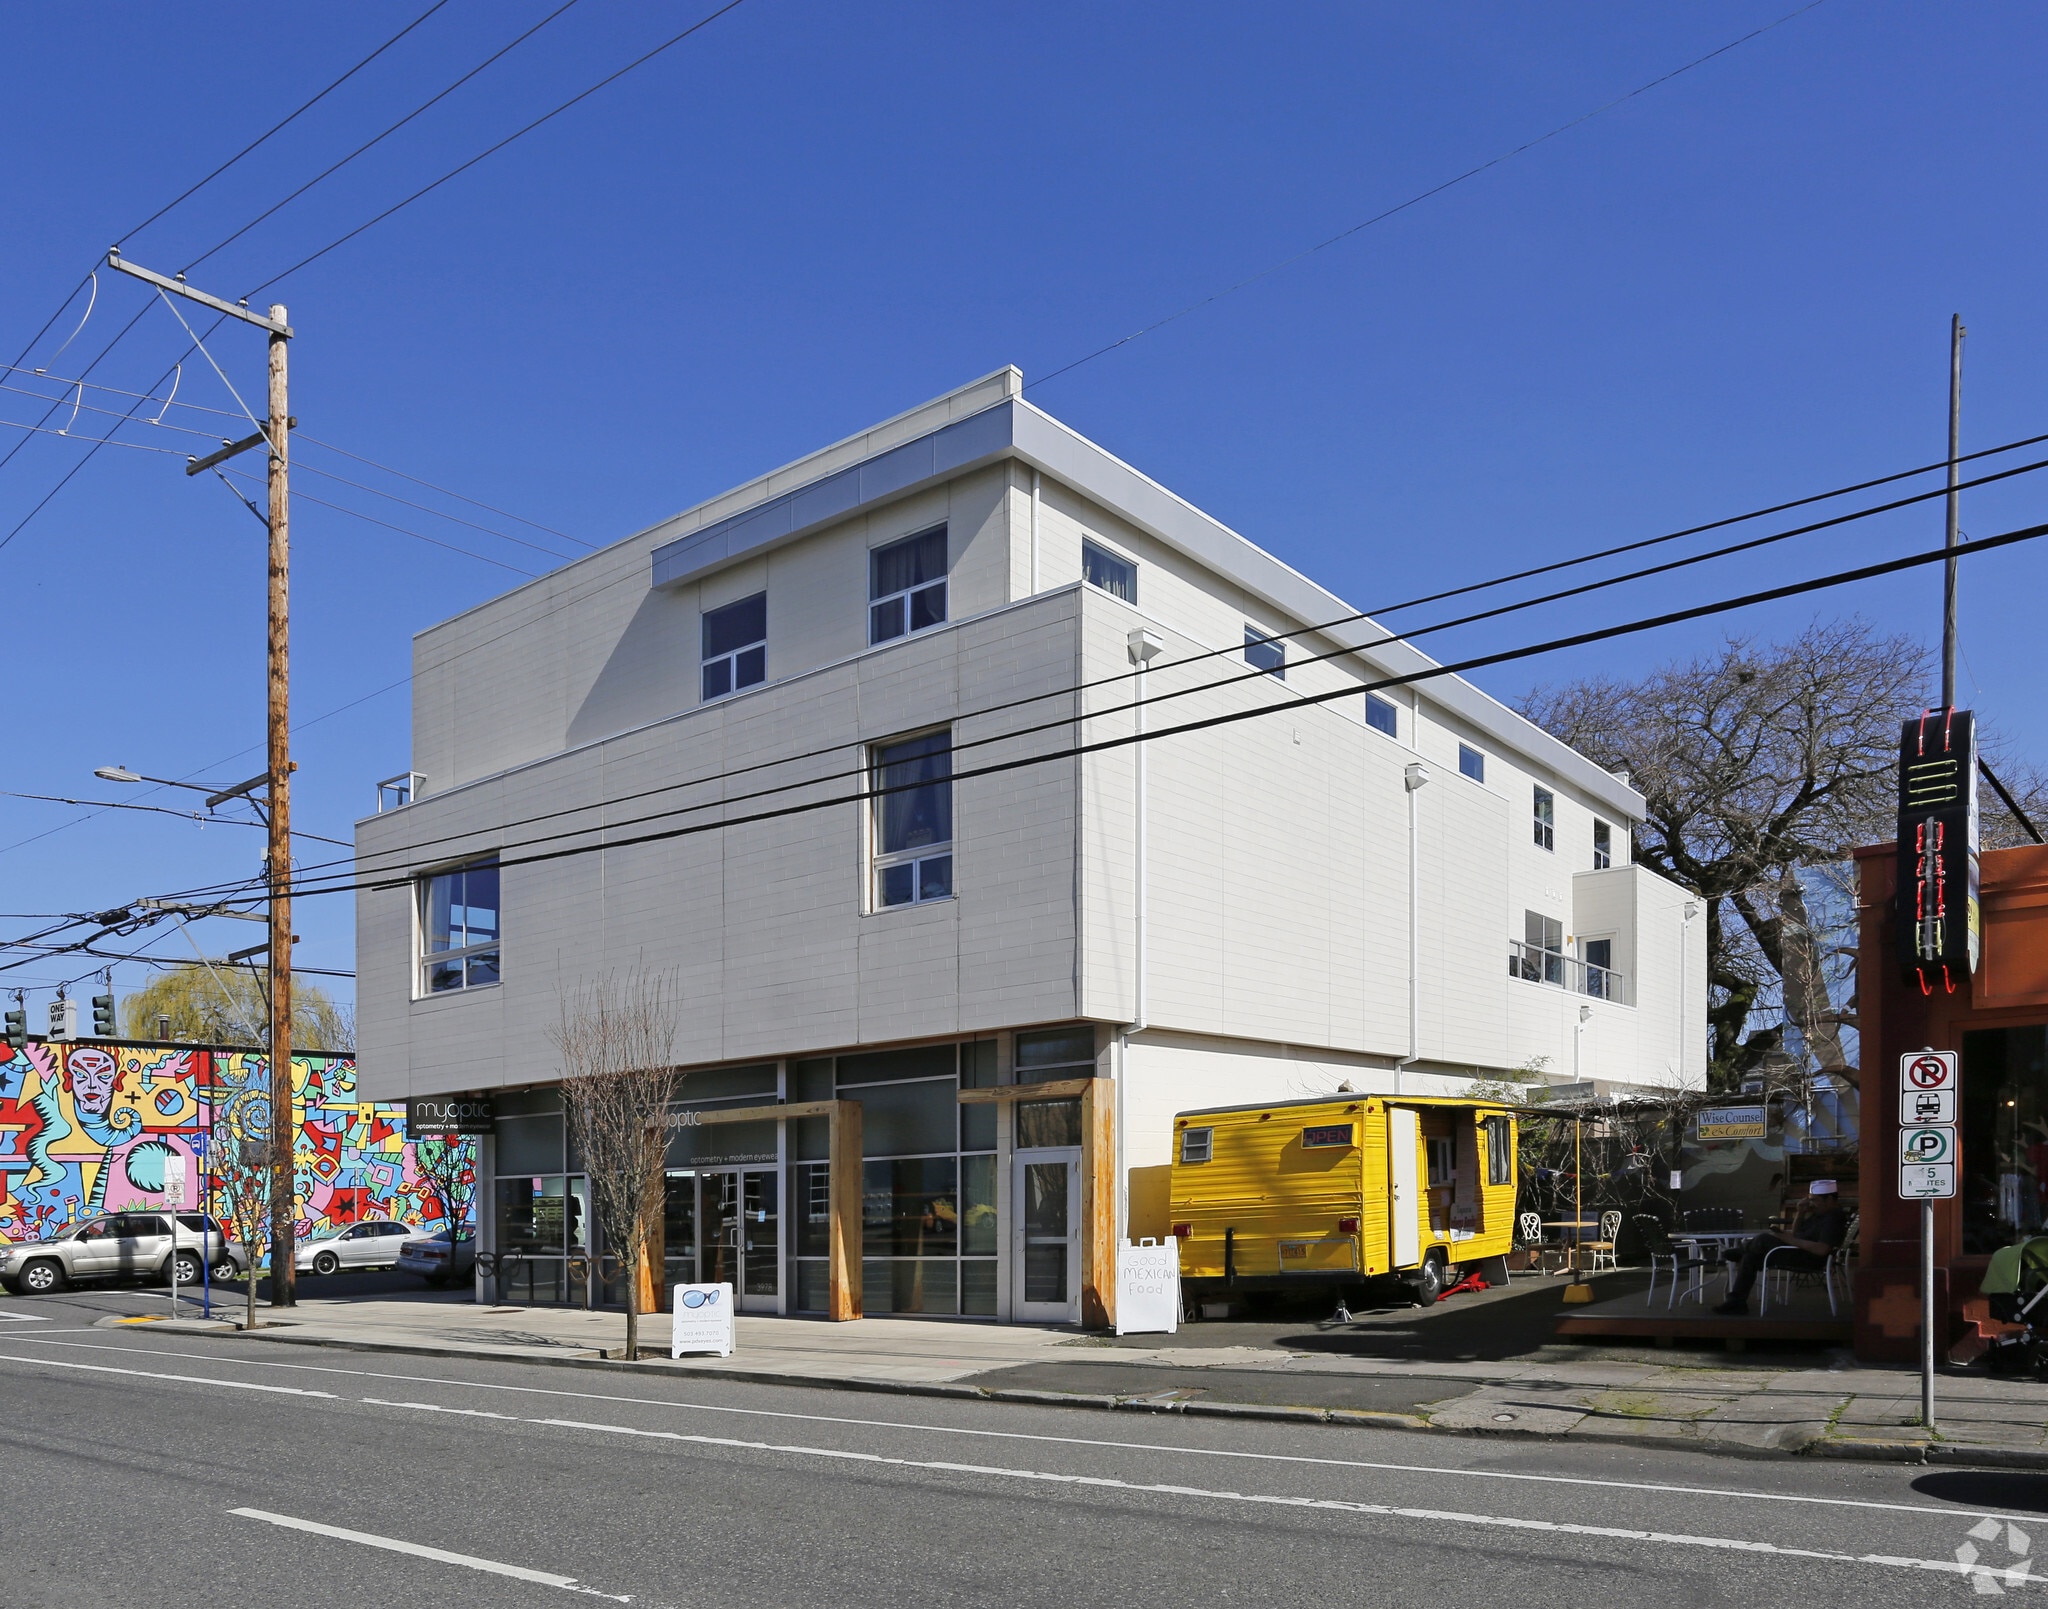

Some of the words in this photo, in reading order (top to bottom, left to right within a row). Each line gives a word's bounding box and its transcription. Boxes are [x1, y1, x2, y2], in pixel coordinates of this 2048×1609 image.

[50, 1003, 65, 1014] ONE
[50, 1012, 65, 1023] WAY
[416, 1101, 491, 1123] myoptic
[1701, 1111, 1725, 1124] Wise
[1725, 1110, 1763, 1123] Counsel
[415, 1123, 445, 1131] optometry
[1725, 1125, 1762, 1137] Comfort
[1304, 1129, 1349, 1145] OPEN
[1919, 1136, 1939, 1156] P
[690, 1155, 724, 1165] optometry
[728, 1153, 753, 1162] modern
[754, 1152, 778, 1162] eyewea
[1123, 1267, 1176, 1281] MEXICAN
